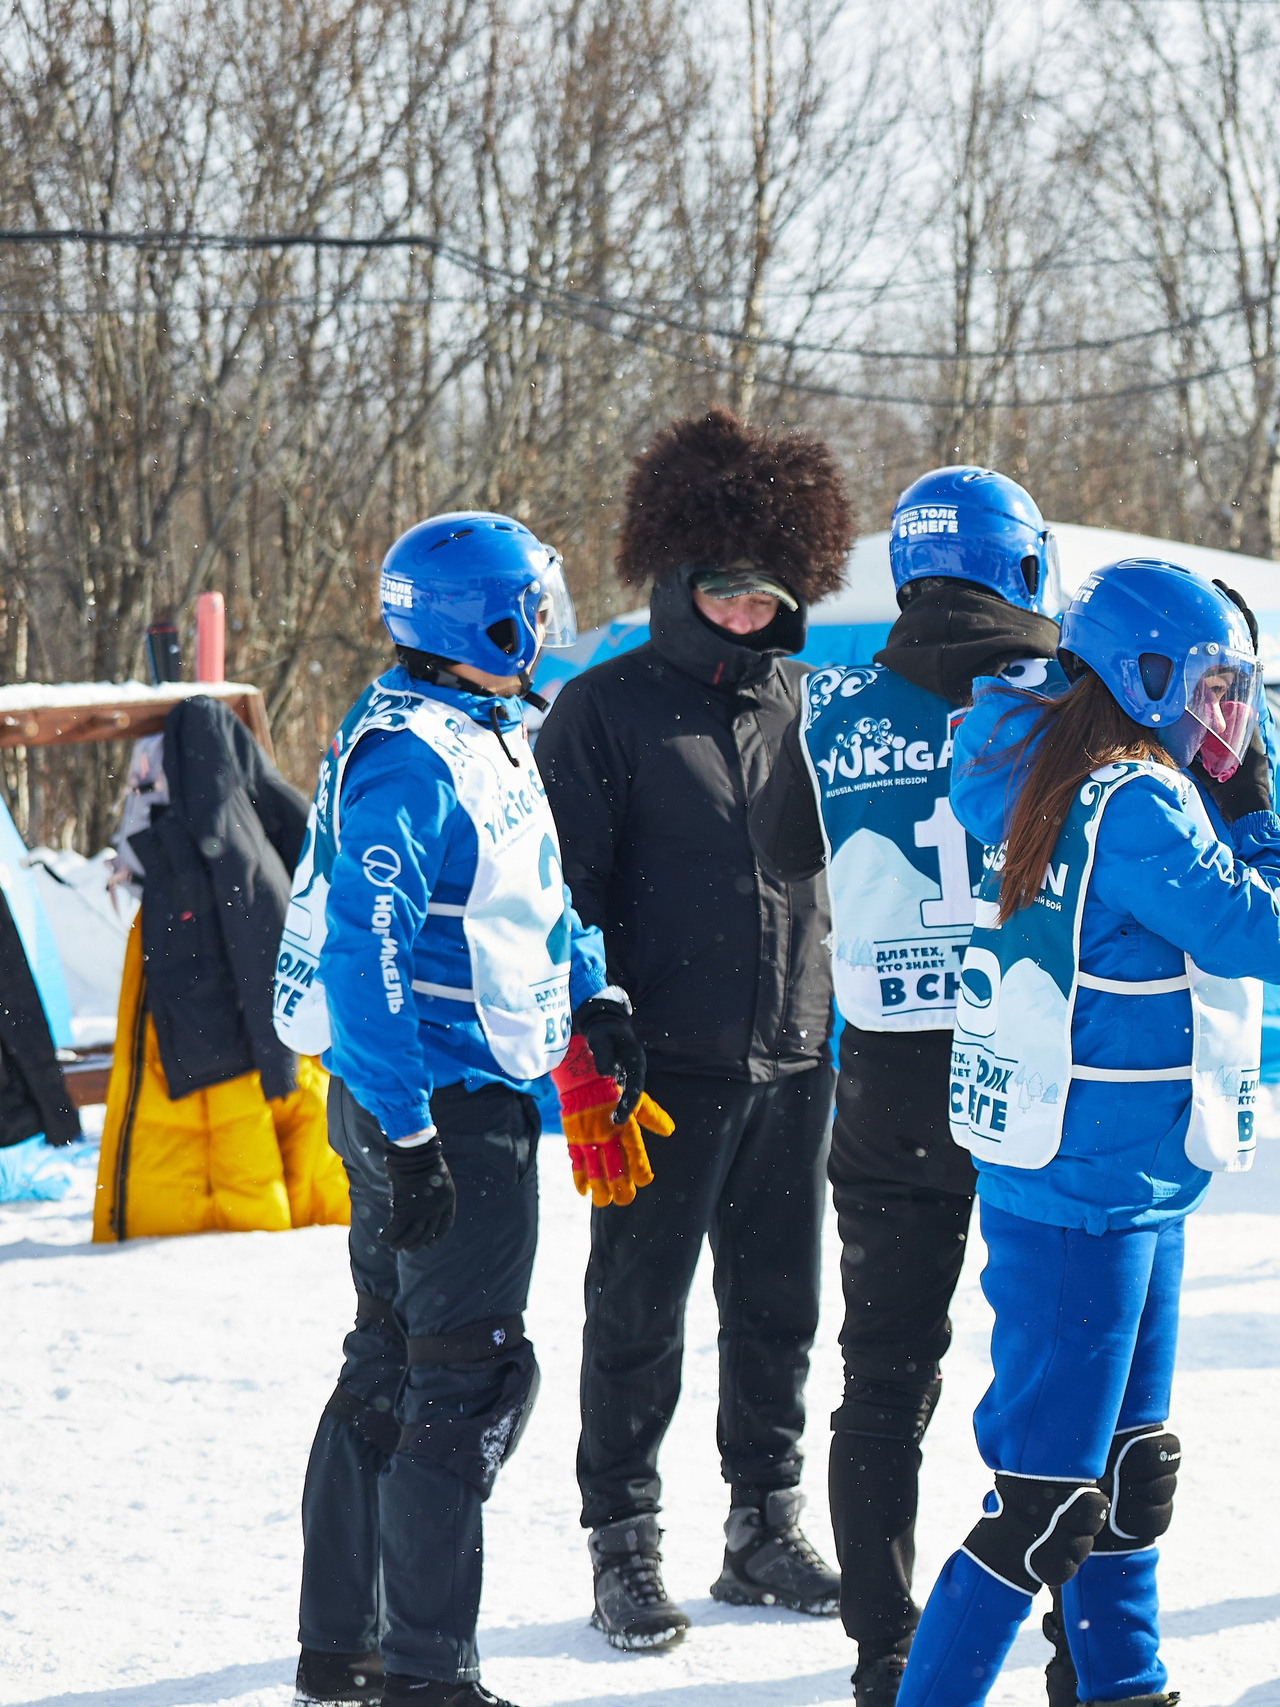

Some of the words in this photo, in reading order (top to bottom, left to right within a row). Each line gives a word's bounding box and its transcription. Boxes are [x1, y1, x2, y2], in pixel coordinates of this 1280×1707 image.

[920, 508, 958, 519] ТОЛК
[899, 525, 908, 538] В
[908, 520, 959, 535] СНЕГЕ
[854, 778, 894, 792] MURMANSK
[895, 776, 928, 786] REGION
[914, 797, 978, 928] 1
[1045, 900, 1062, 912] БОЙ
[876, 949, 908, 963] ДЛЯ
[911, 946, 944, 958] ТЕХ,
[877, 963, 903, 974] КТО
[906, 959, 946, 970] ЗНАЕТ
[278, 952, 317, 989] ОЛК
[276, 980, 303, 1018] ГЕ
[880, 977, 907, 1007] В
[916, 972, 960, 1000] СН
[545, 1018, 556, 1045] В
[977, 1054, 1014, 1094] ОЛК
[1238, 1111, 1255, 1142] В
